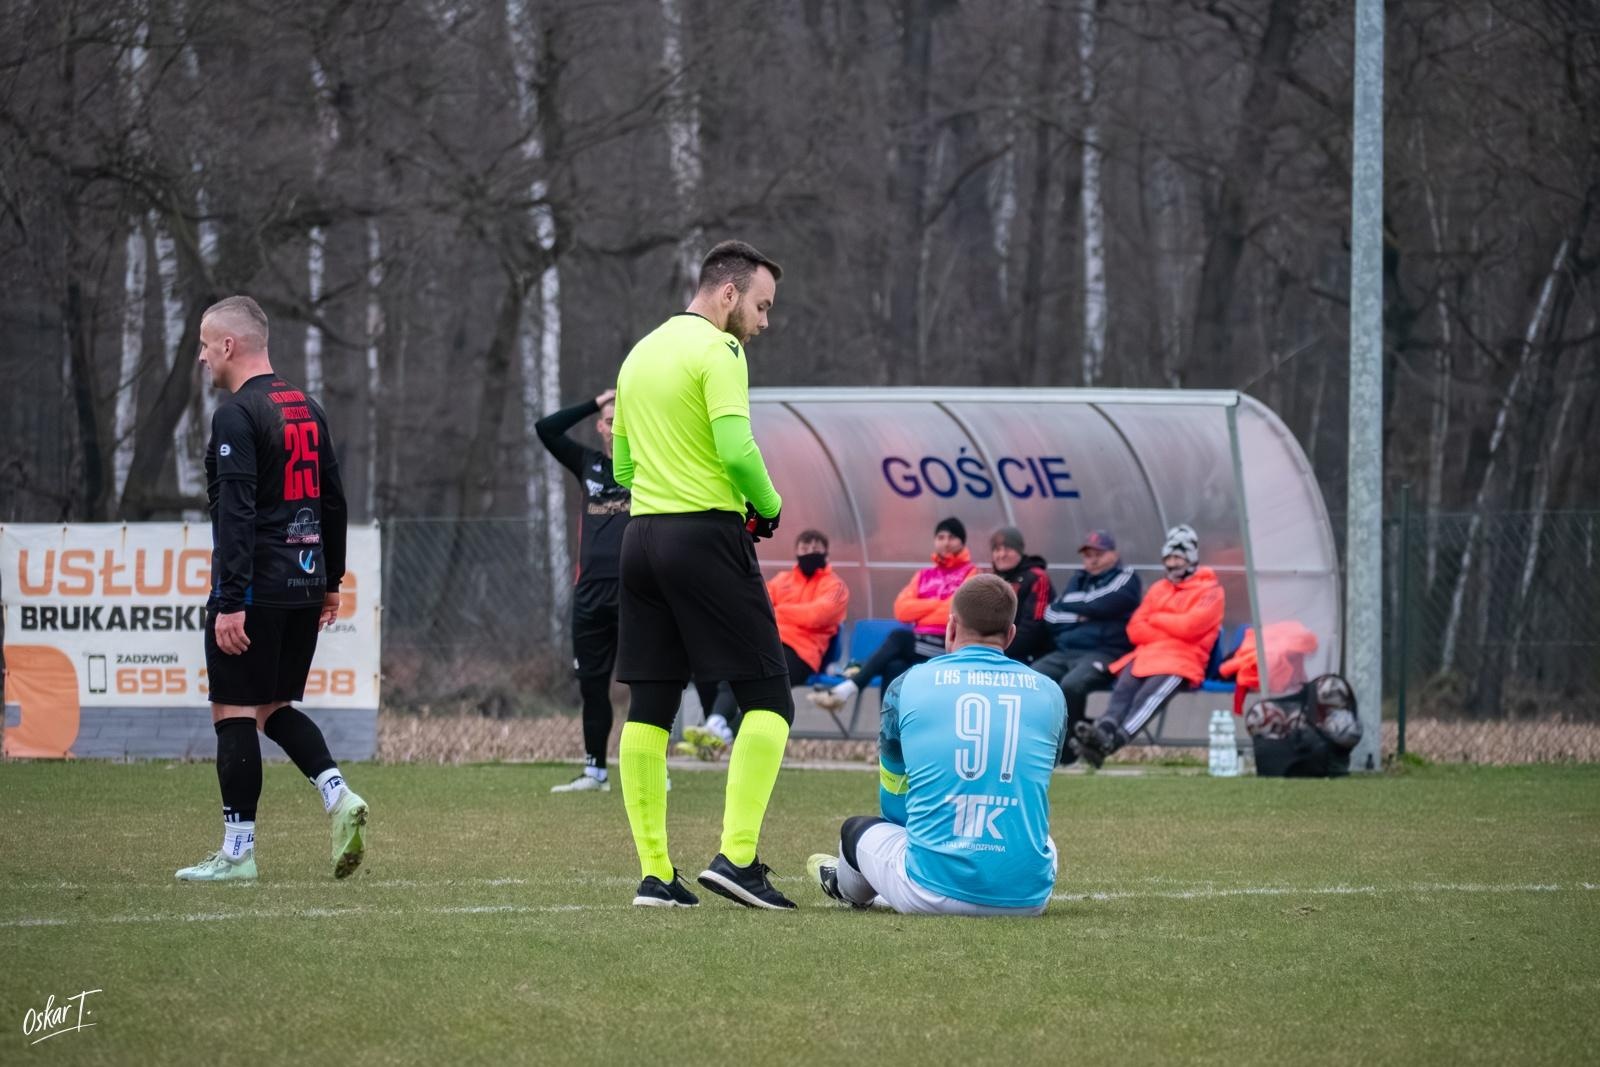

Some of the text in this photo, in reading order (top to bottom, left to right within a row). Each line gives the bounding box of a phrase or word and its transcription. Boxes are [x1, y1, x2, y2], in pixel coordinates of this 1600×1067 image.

[283, 421, 320, 500] 25
[882, 447, 1080, 499] GOŚCIE
[18, 548, 212, 597] USŁUG
[21, 604, 208, 632] BRUKARSKI
[116, 653, 179, 665] ZADZWOŃ
[116, 668, 188, 695] 695
[304, 668, 357, 696] 98
[955, 692, 1022, 783] 91
